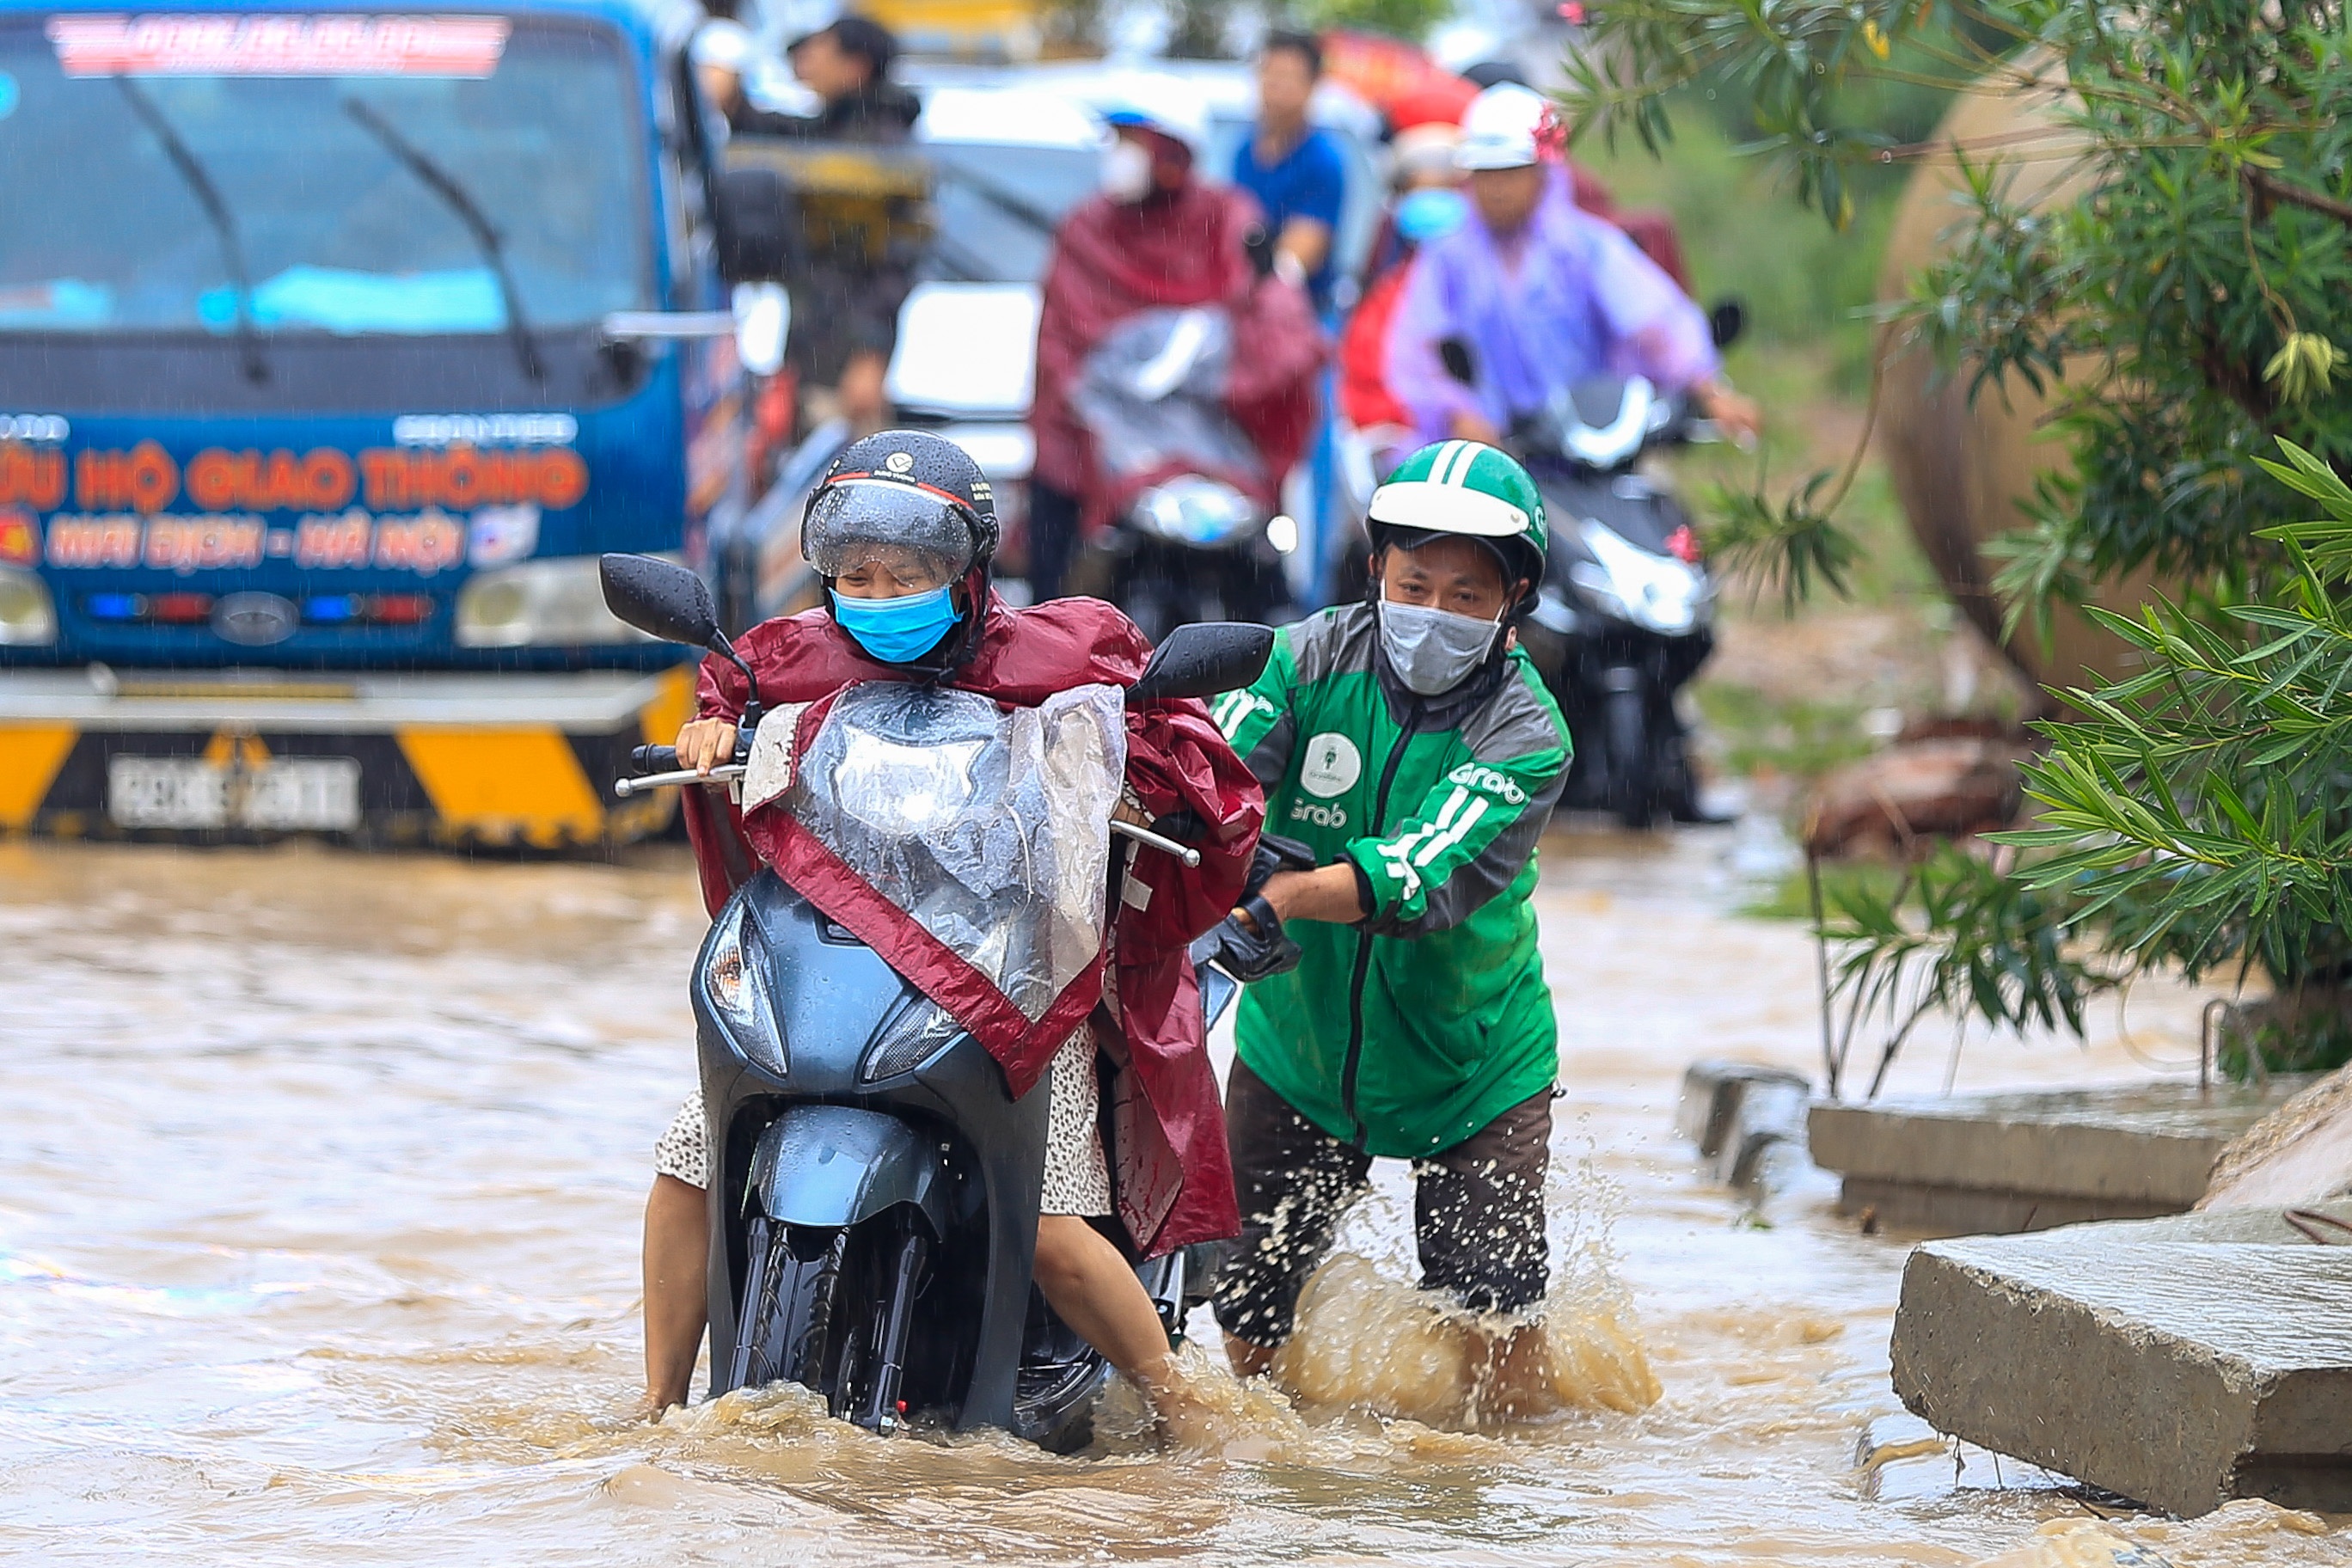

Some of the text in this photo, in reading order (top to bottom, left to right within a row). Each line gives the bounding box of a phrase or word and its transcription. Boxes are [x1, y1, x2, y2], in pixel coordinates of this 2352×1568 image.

[186, 447, 357, 512] GIAO
[357, 440, 589, 513] THÔNG
[1448, 762, 1525, 805] Grab
